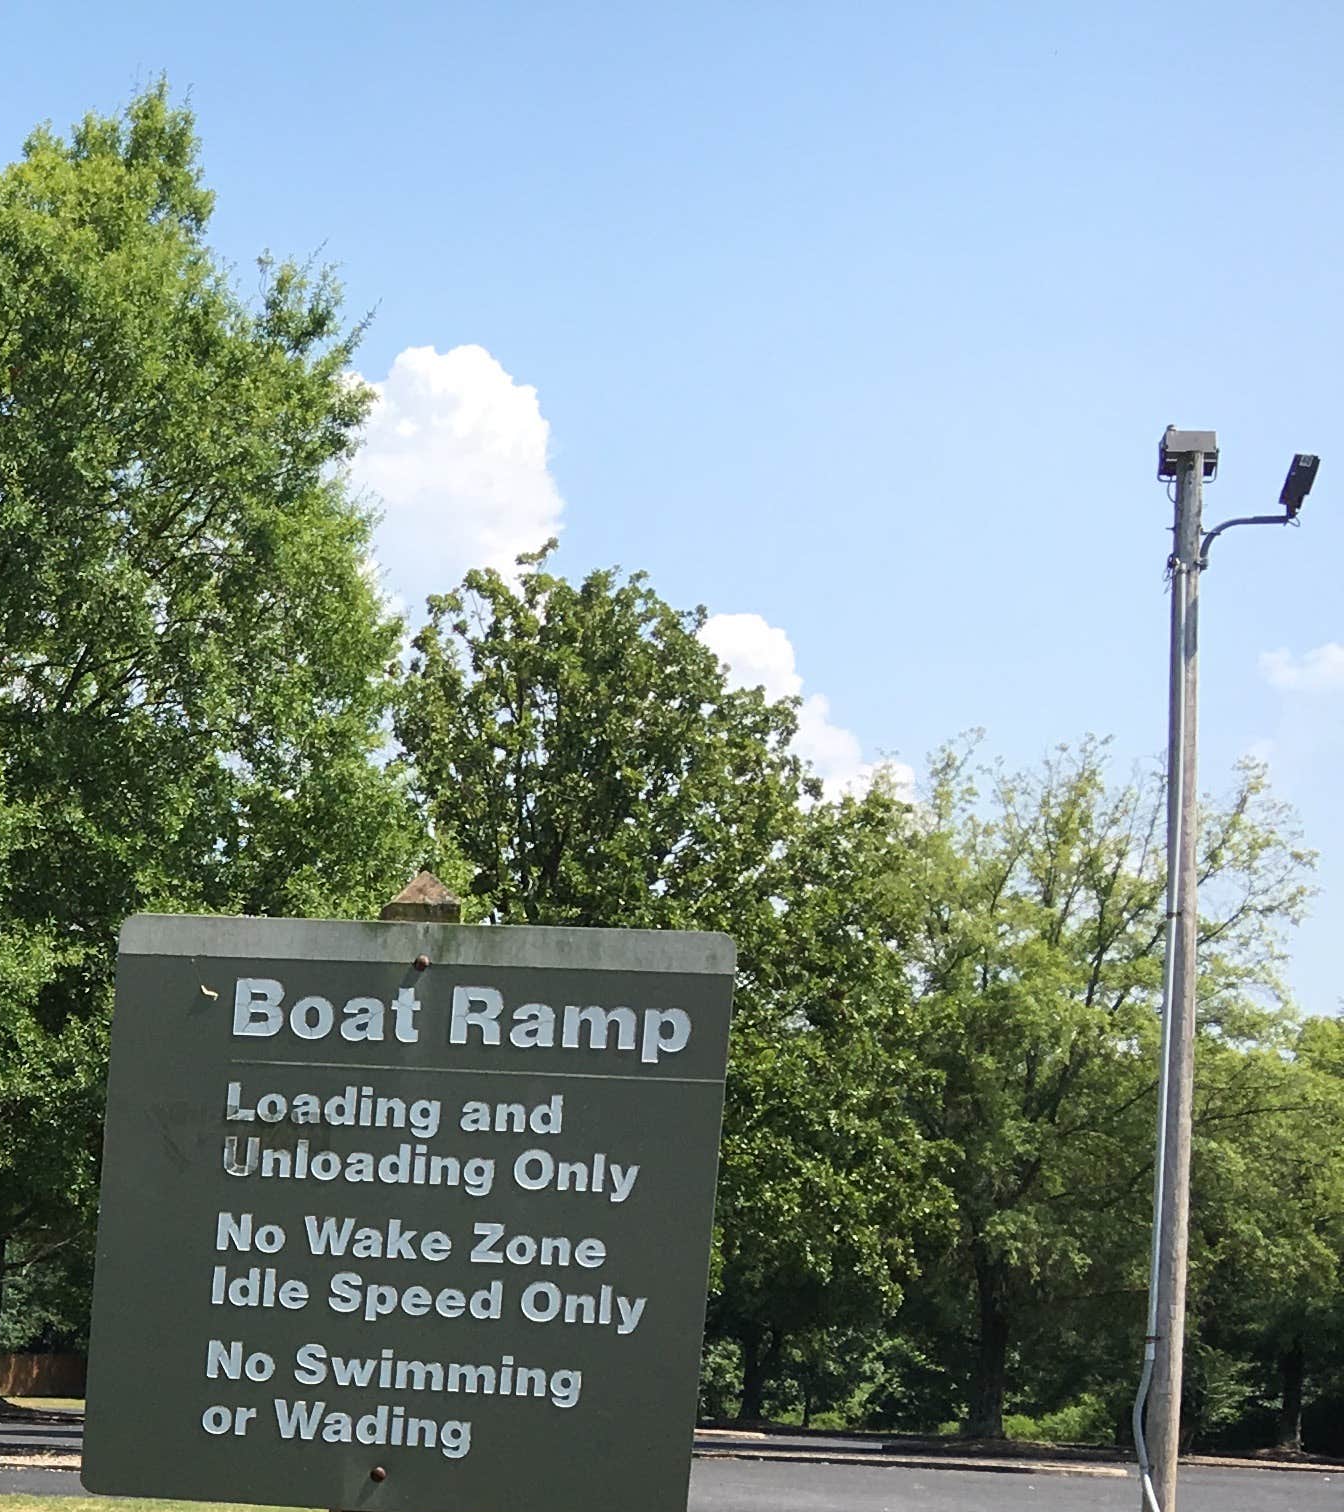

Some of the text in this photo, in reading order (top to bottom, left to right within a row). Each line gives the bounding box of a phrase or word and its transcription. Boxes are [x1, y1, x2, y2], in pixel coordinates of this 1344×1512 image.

[234, 978, 693, 1063] Boat Ramp
[226, 1082, 563, 1138] Loading and
[223, 1136, 640, 1202] Unloading Only
[216, 1212, 605, 1267] No Wake Zone
[212, 1266, 648, 1335] Idle Speed Only
[207, 1340, 583, 1408] No Swimming
[202, 1400, 470, 1457] or Wading
